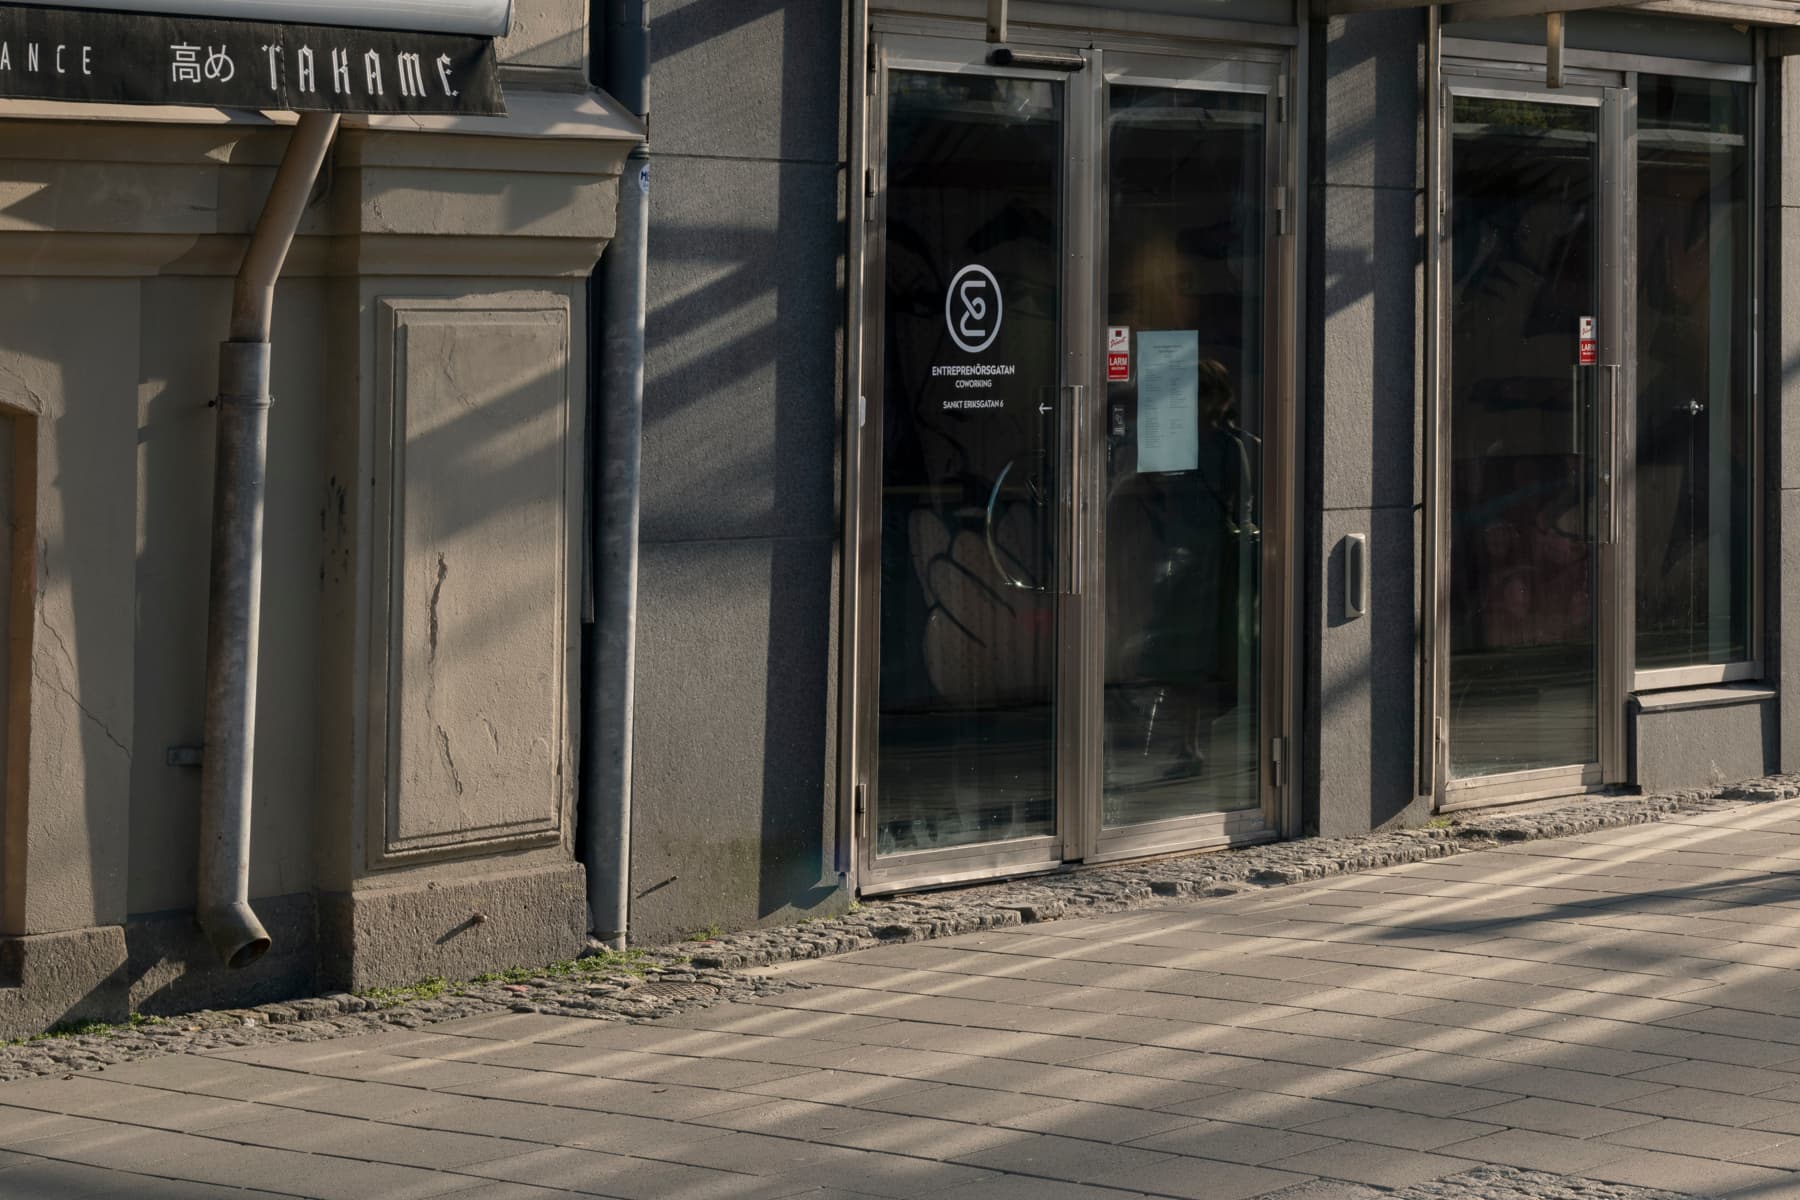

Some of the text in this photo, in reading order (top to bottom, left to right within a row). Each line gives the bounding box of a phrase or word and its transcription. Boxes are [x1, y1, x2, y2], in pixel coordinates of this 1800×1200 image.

[169, 40, 236, 84] 高め
[260, 42, 460, 98] TAKAME
[1109, 357, 1128, 366] LARM
[932, 363, 1015, 376] ENTREPRENÖRSGATAN
[955, 379, 992, 388] COWORKING
[943, 399, 1005, 409] SANKT ERIKSGATAN 6
